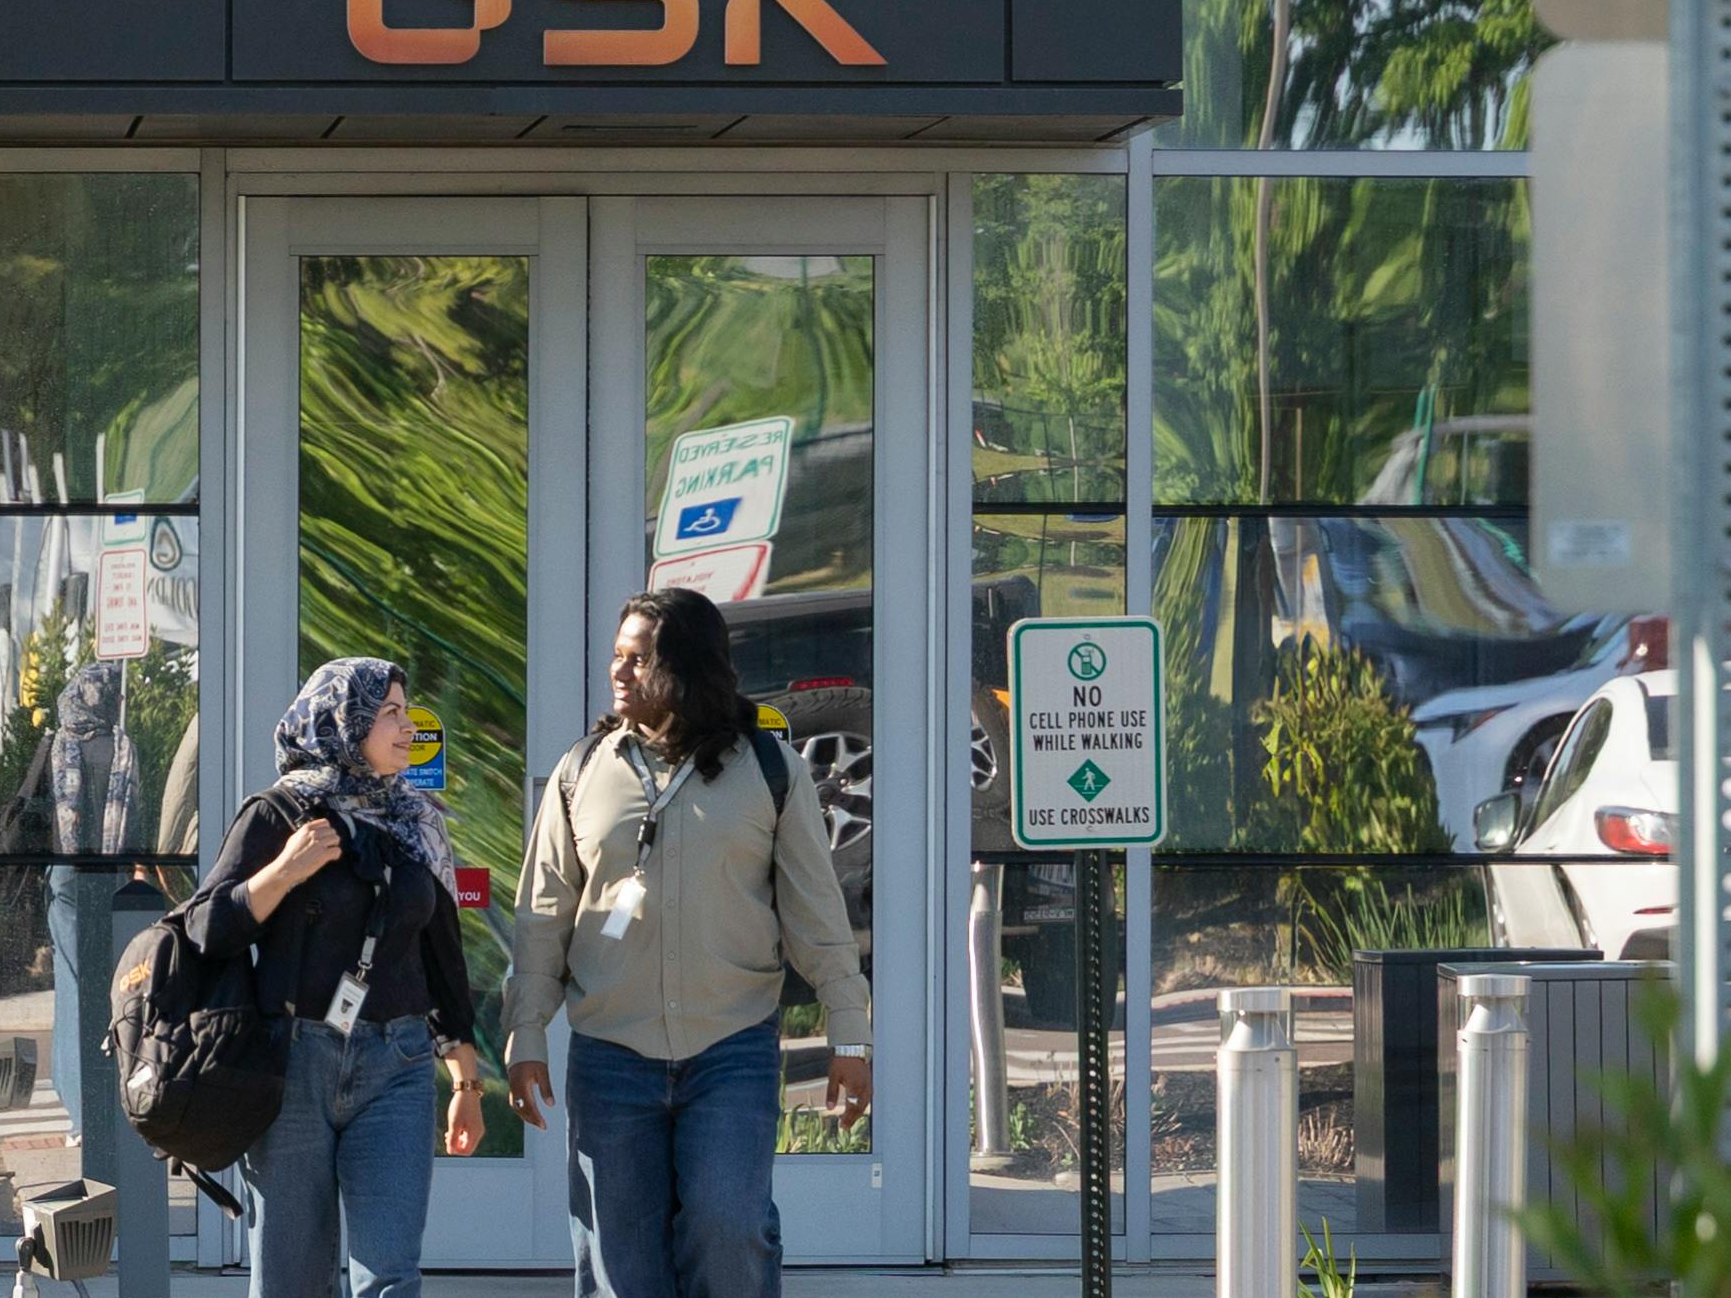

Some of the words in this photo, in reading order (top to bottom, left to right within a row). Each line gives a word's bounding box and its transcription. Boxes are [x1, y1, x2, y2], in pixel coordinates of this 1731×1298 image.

[1074, 686, 1102, 707] NO
[1029, 712, 1062, 730] CELL
[1068, 711, 1114, 728] PHONE
[1121, 710, 1147, 727] USE
[410, 733, 438, 742] TION
[1033, 734, 1076, 751] WHILE
[1081, 733, 1143, 750] WALKING
[1029, 809, 1055, 826] USE
[1061, 806, 1150, 825] CROSSWALKS
[458, 891, 481, 901] YOU
